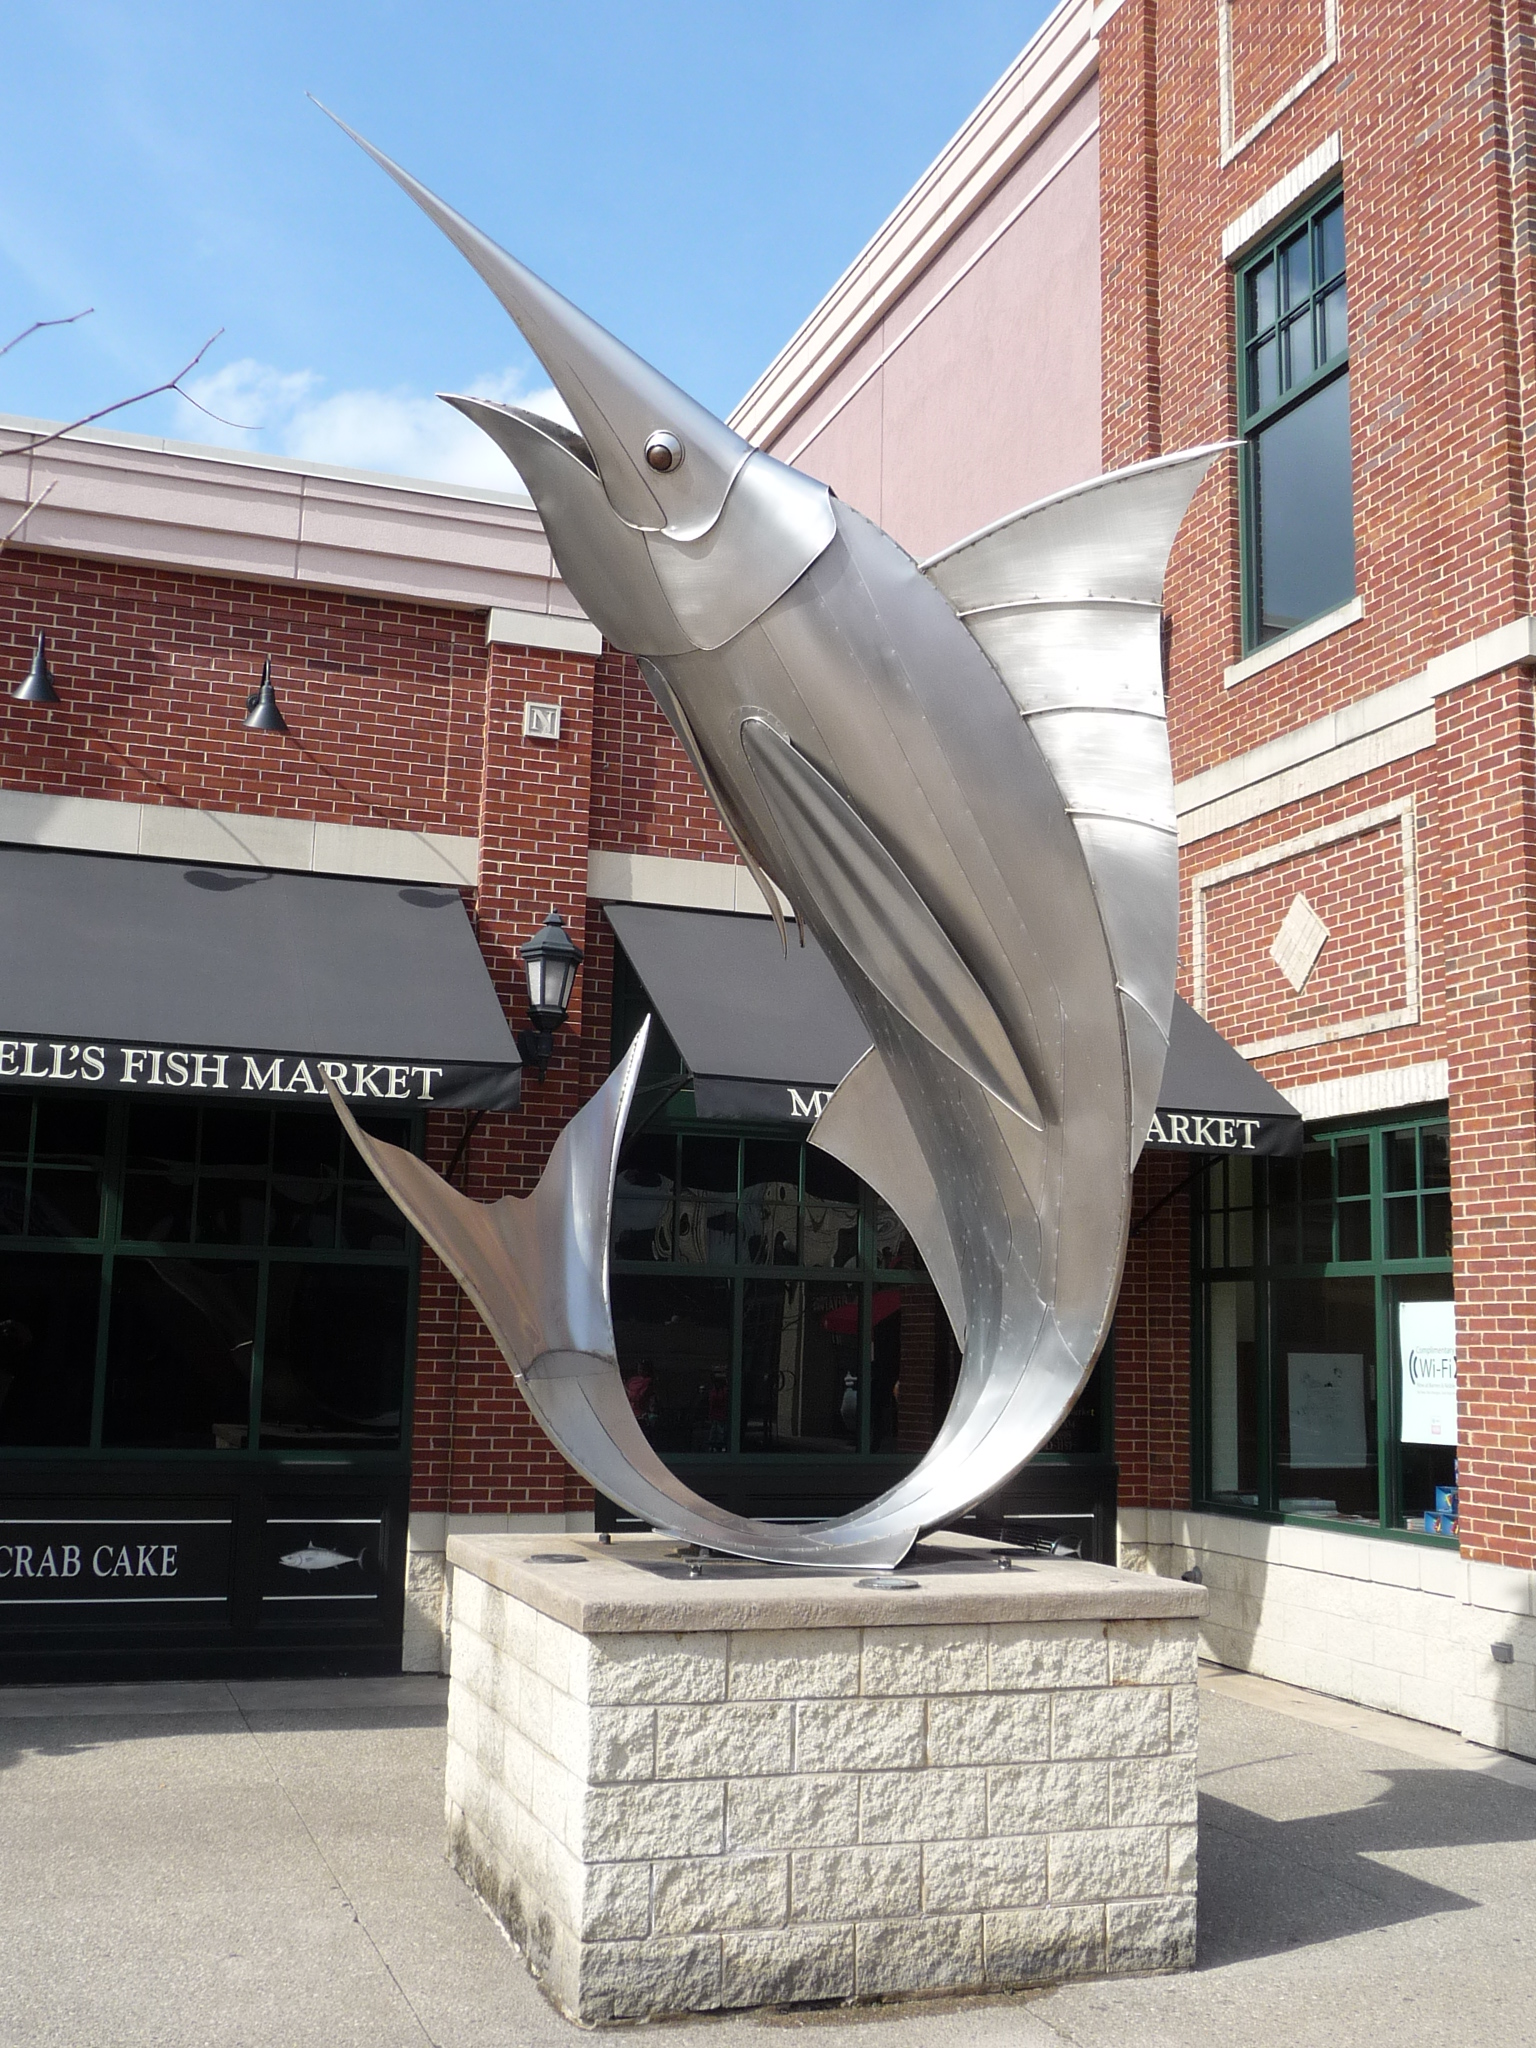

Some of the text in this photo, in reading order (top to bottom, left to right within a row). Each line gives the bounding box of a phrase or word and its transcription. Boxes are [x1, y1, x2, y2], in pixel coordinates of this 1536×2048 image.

[530, 708, 556, 736] N
[120, 1048, 229, 1089] FISH
[241, 1056, 443, 1101] MARKET
[1145, 1113, 1261, 1149] ARKET
[1419, 1358, 1452, 1379] Wi-Fi
[0, 1545, 178, 1578] CRAB CAKE
